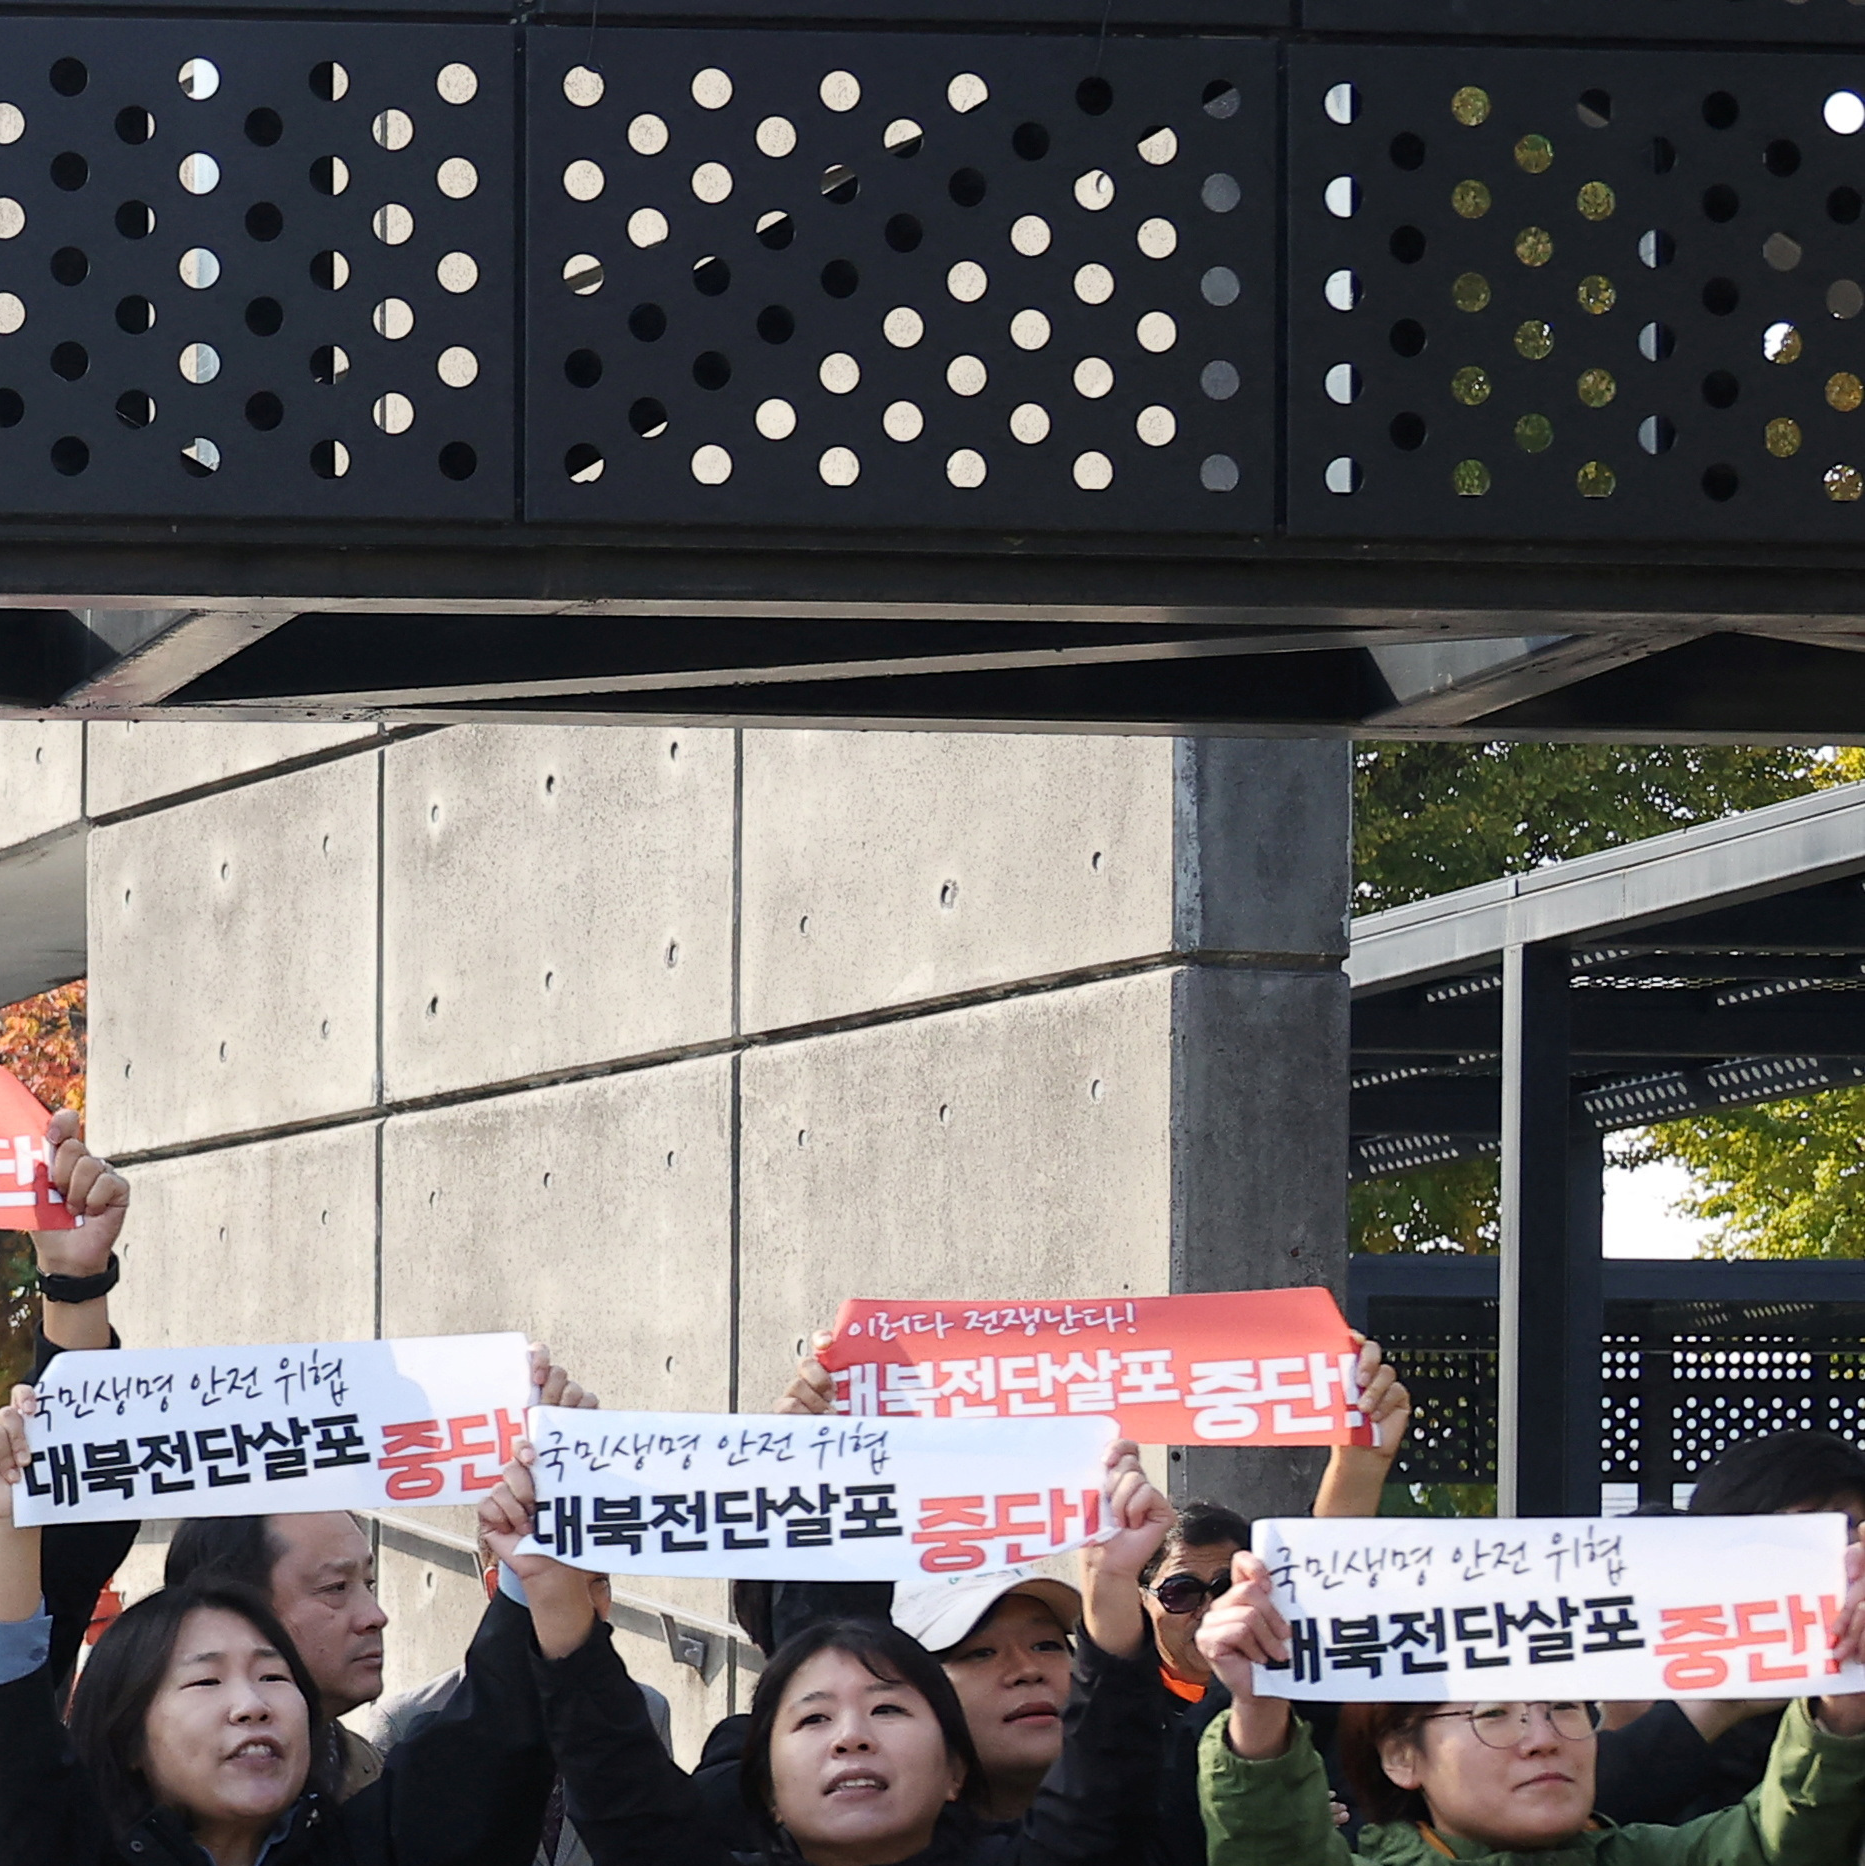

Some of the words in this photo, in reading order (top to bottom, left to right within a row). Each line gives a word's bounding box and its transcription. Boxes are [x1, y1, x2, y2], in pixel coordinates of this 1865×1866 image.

[847, 1312, 953, 1341] 이러다
[962, 1301, 1138, 1338] 전쟁난다!
[33, 1370, 174, 1432] 국민생명
[190, 1363, 261, 1410] 안전
[274, 1348, 350, 1409] 위협
[829, 1349, 1181, 1417] 대북전단살포
[1184, 1351, 1363, 1439] 중단!
[23, 1412, 371, 1507] 대북전단살포
[376, 1406, 529, 1501] 중단
[538, 1430, 701, 1483] 국민생명
[717, 1428, 796, 1468] 안전
[808, 1419, 890, 1471] 위협
[532, 1482, 904, 1557] 대북전단살포
[1268, 1543, 1432, 1602] 국민생명
[1451, 1538, 1531, 1580] 안전
[1546, 1525, 1628, 1587] 위협
